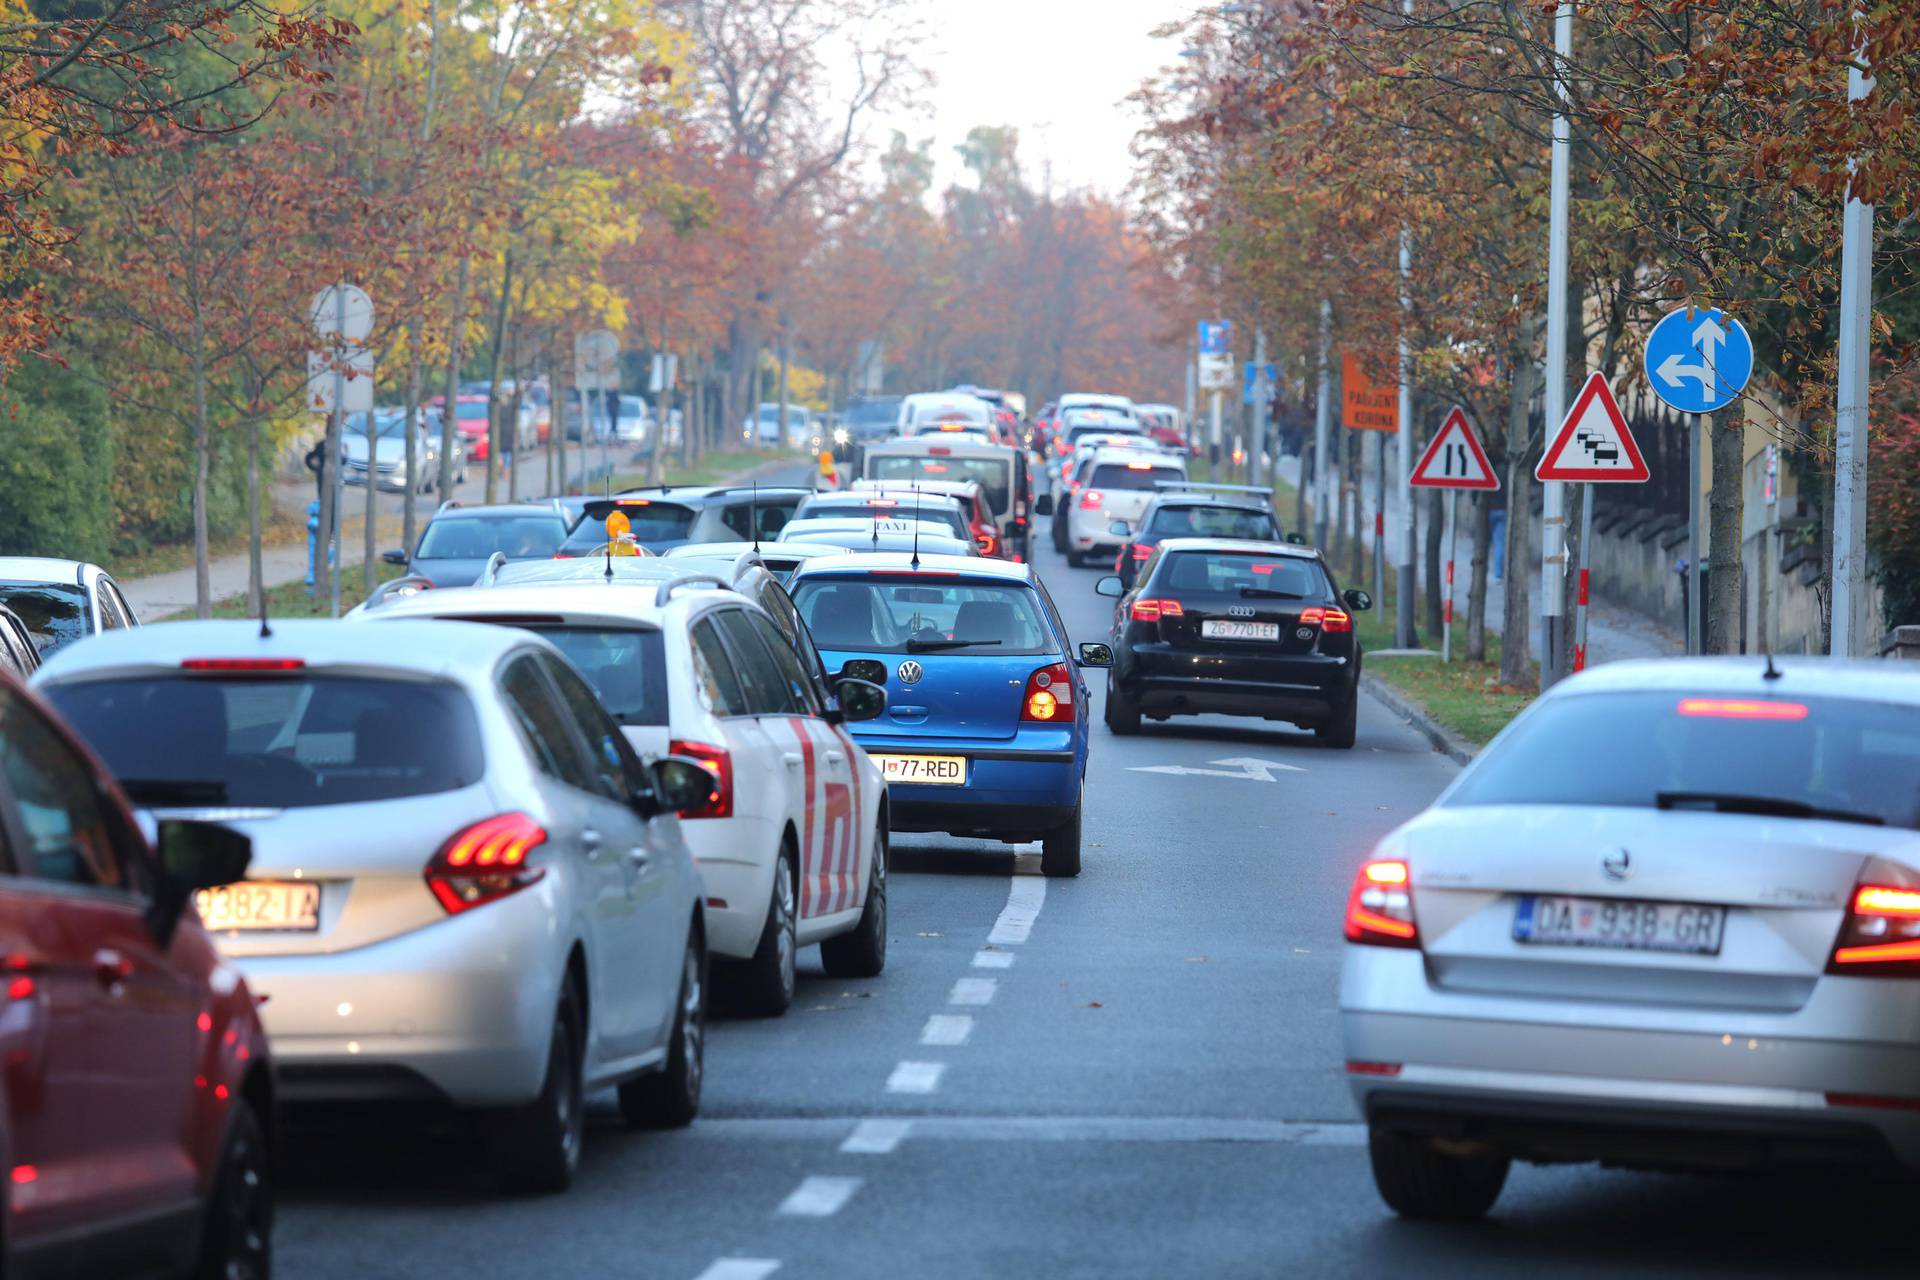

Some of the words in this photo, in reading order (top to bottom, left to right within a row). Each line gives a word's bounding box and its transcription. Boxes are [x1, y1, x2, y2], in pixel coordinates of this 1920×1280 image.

[1354, 411, 1393, 426] KORONA
[874, 521, 907, 531] TAXI
[1211, 622, 1225, 635] ZG
[900, 759, 959, 778] 77-RED
[1538, 898, 1573, 932] DA
[1599, 901, 1715, 943] 938-GR
